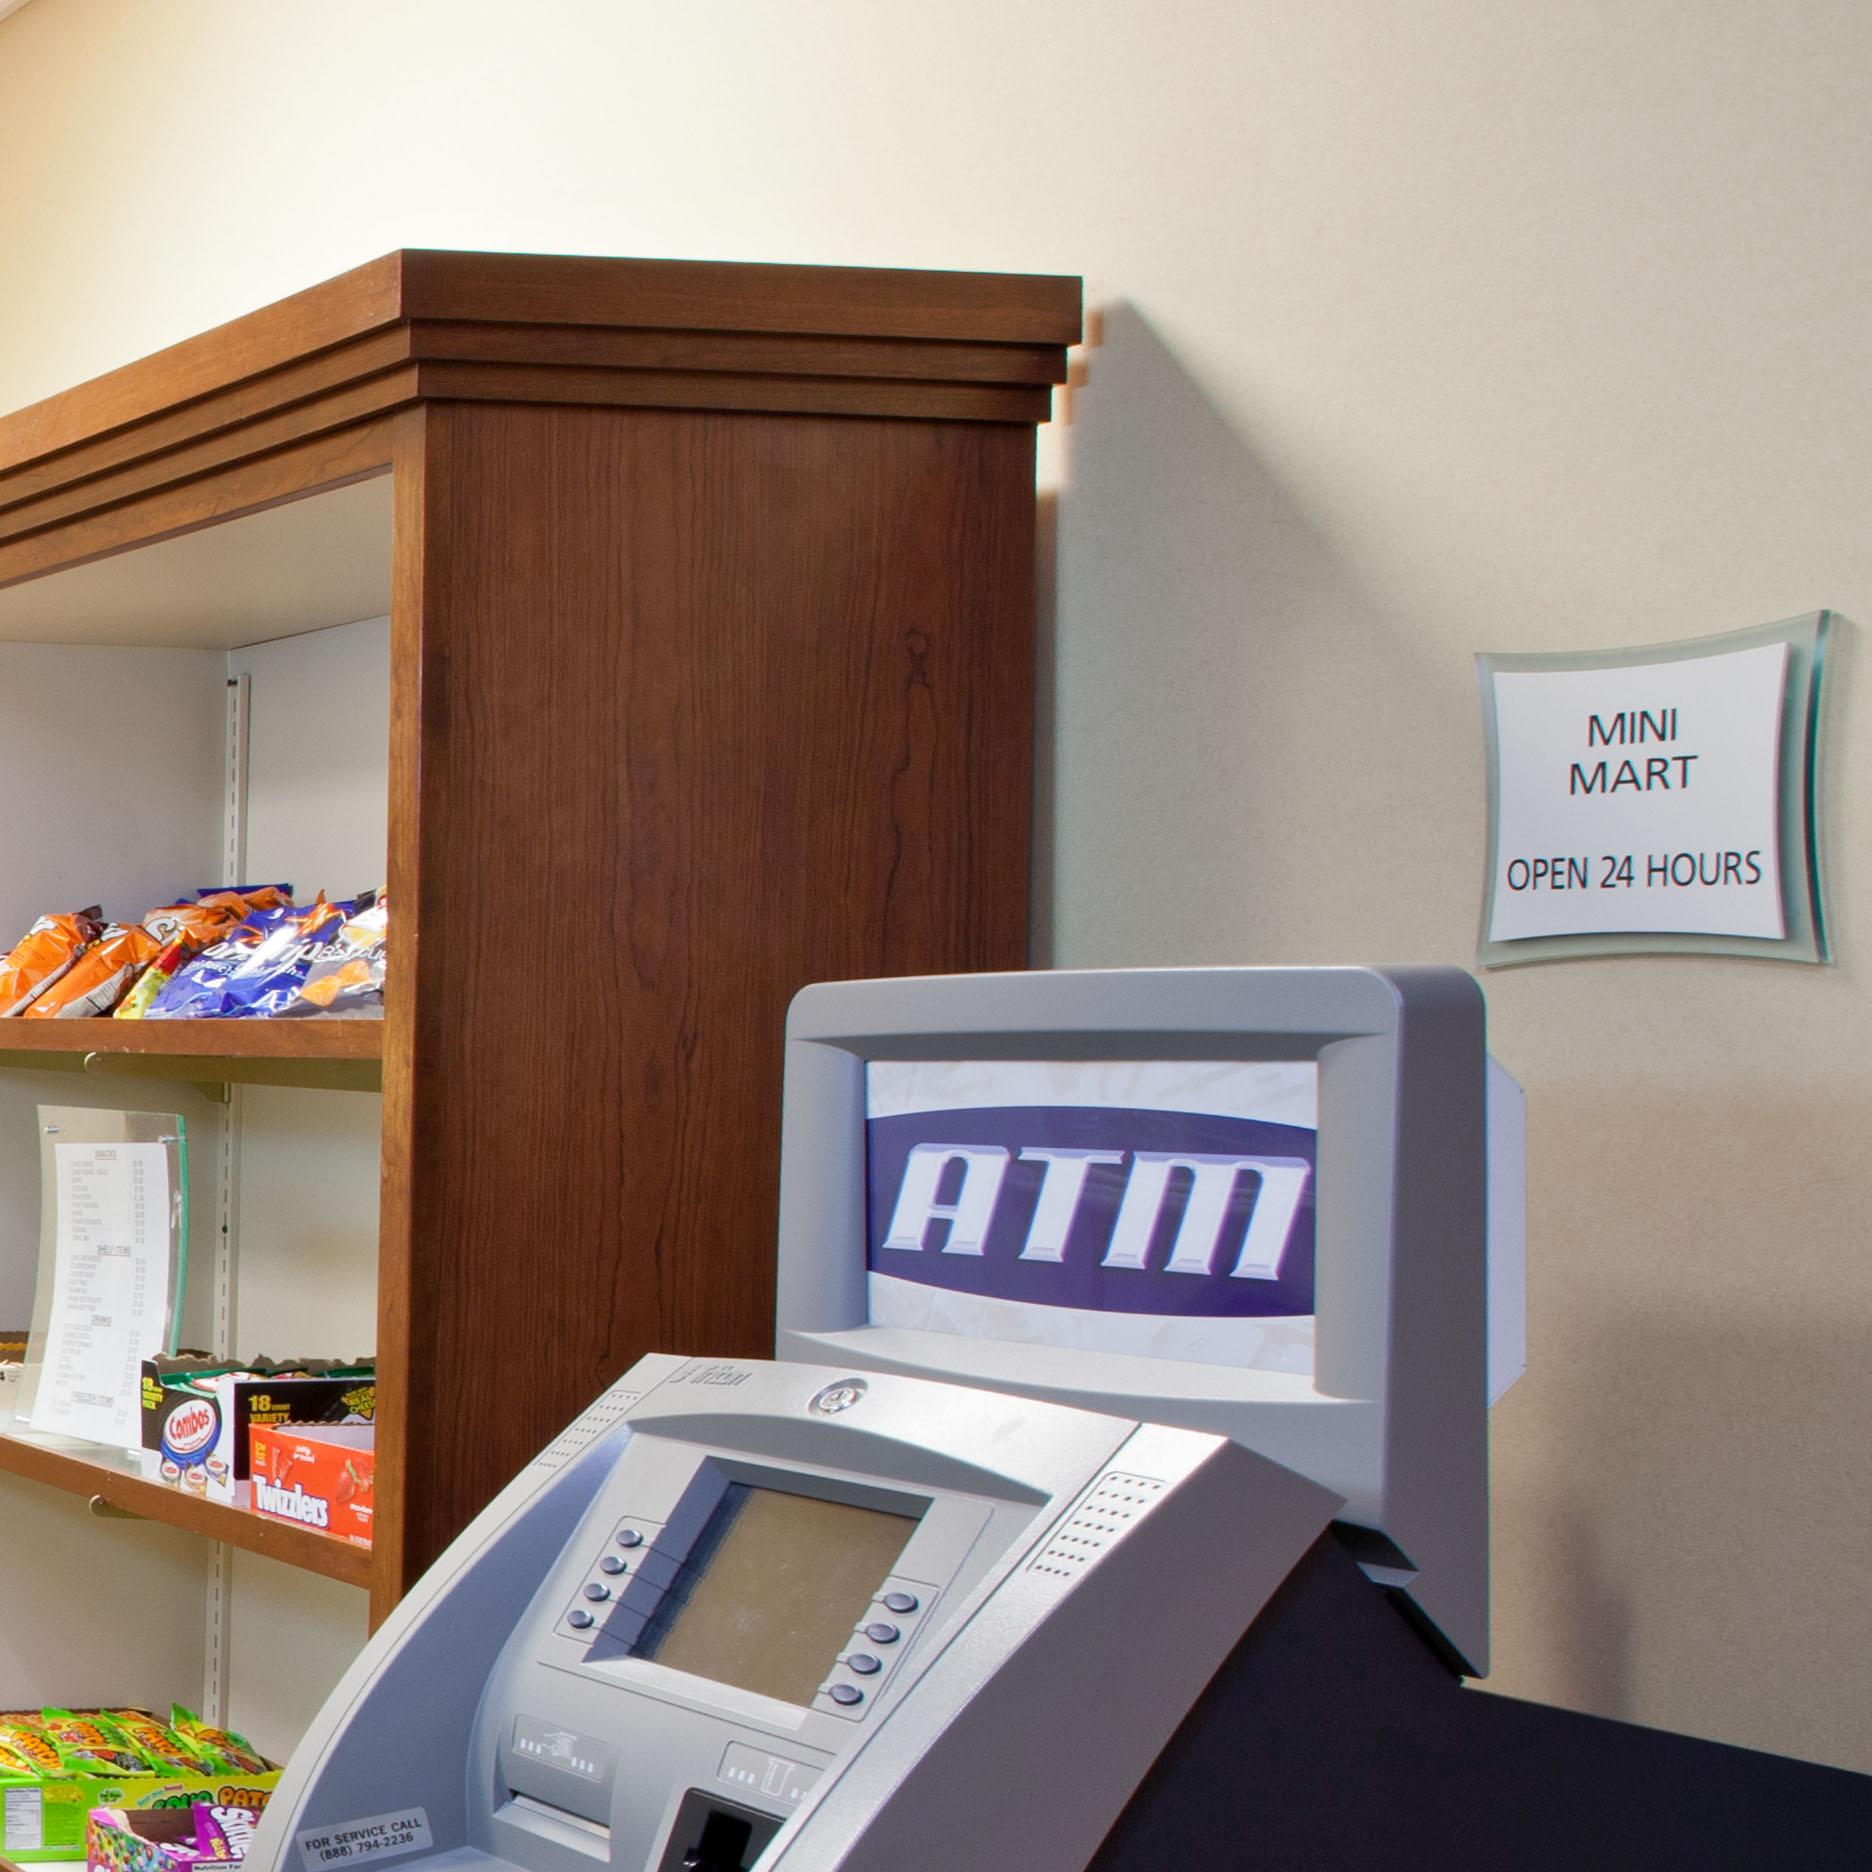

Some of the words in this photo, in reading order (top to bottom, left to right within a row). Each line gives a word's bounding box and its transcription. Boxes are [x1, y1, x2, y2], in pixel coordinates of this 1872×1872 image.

[1587, 707, 1679, 748] MINI
[1568, 754, 1699, 796] MART
[1506, 856, 1588, 892] OPEN
[1599, 854, 1635, 890] 24
[1646, 850, 1762, 888] HOURS
[881, 1143, 1312, 1282] ATM
[169, 1406, 210, 1441] Combos
[248, 1395, 271, 1412] 18
[252, 1473, 329, 1528] Twizzlers
[304, 1836, 331, 1851] FOR
[334, 1824, 388, 1845] SERVICE
[390, 1817, 423, 1833] CALL
[319, 1843, 353, 1862] (888)
[355, 1831, 414, 1853] 794-2236
